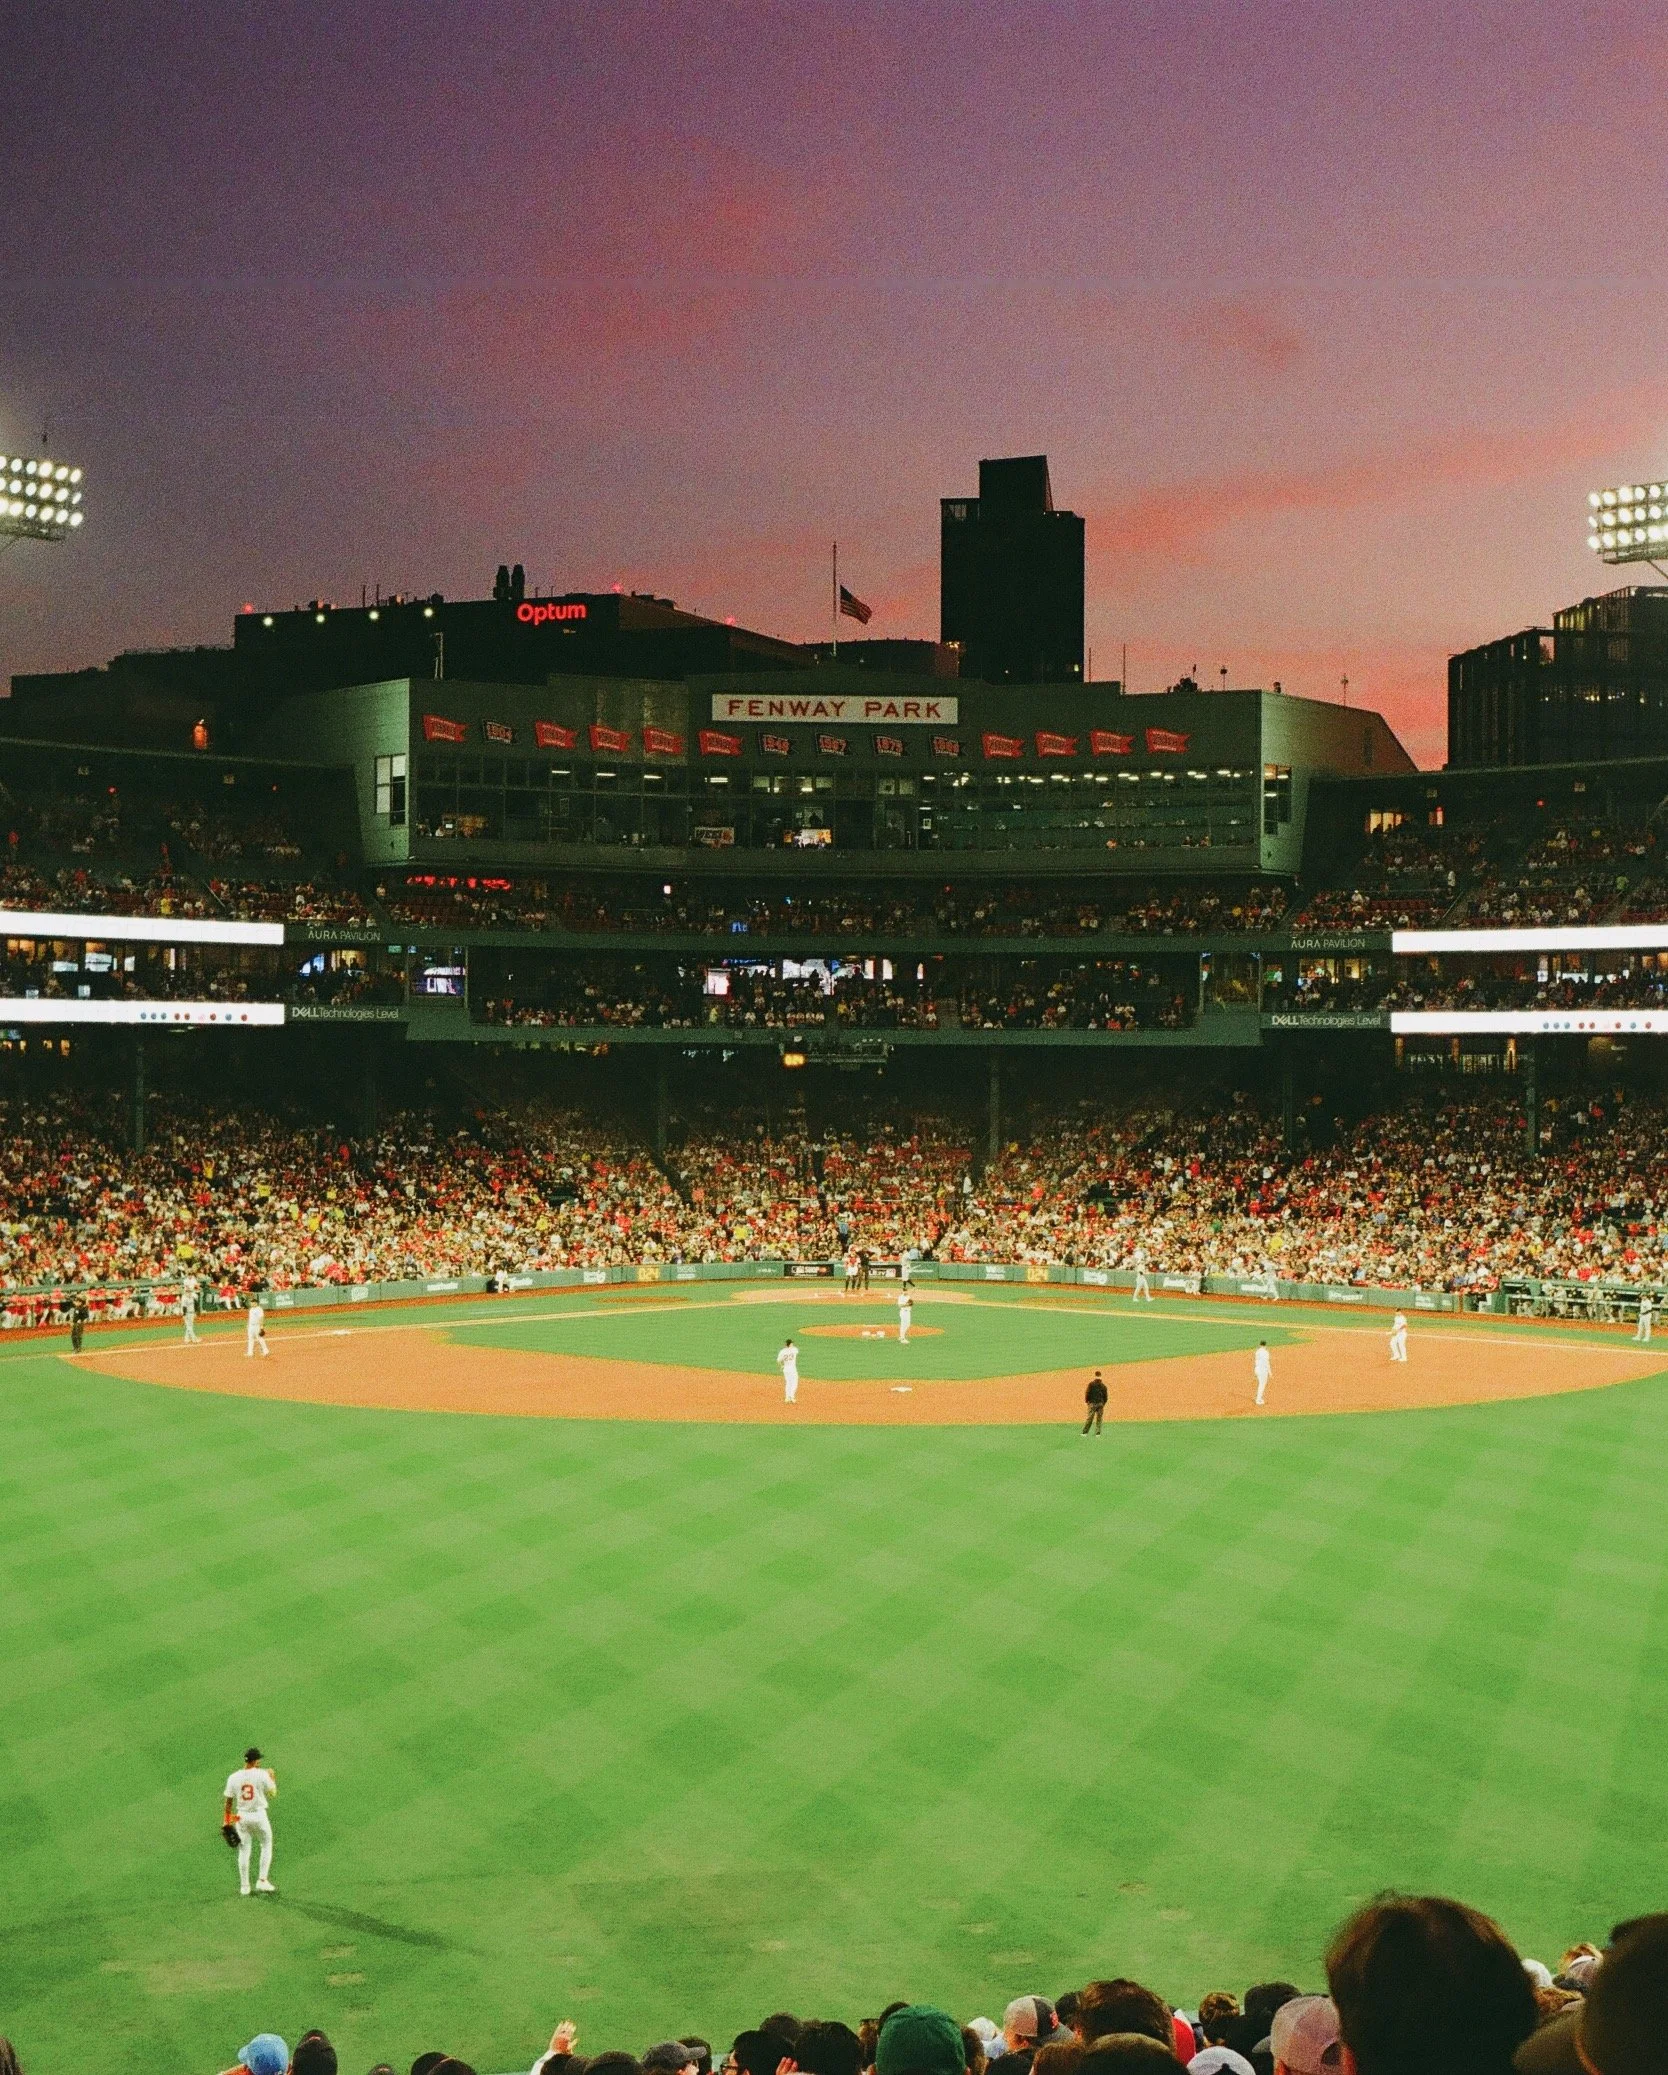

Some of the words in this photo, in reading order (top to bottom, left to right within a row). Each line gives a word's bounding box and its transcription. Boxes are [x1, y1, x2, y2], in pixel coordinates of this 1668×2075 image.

[517, 603, 587, 625] Optum
[728, 699, 845, 717] FENWAY
[864, 701, 941, 719] PARK
[340, 930, 381, 941] PAVILION
[1323, 940, 1366, 948] PAVILION
[376, 1008, 399, 1019] Level
[1357, 1015, 1380, 1026] Level
[241, 1784, 254, 1801] 3
